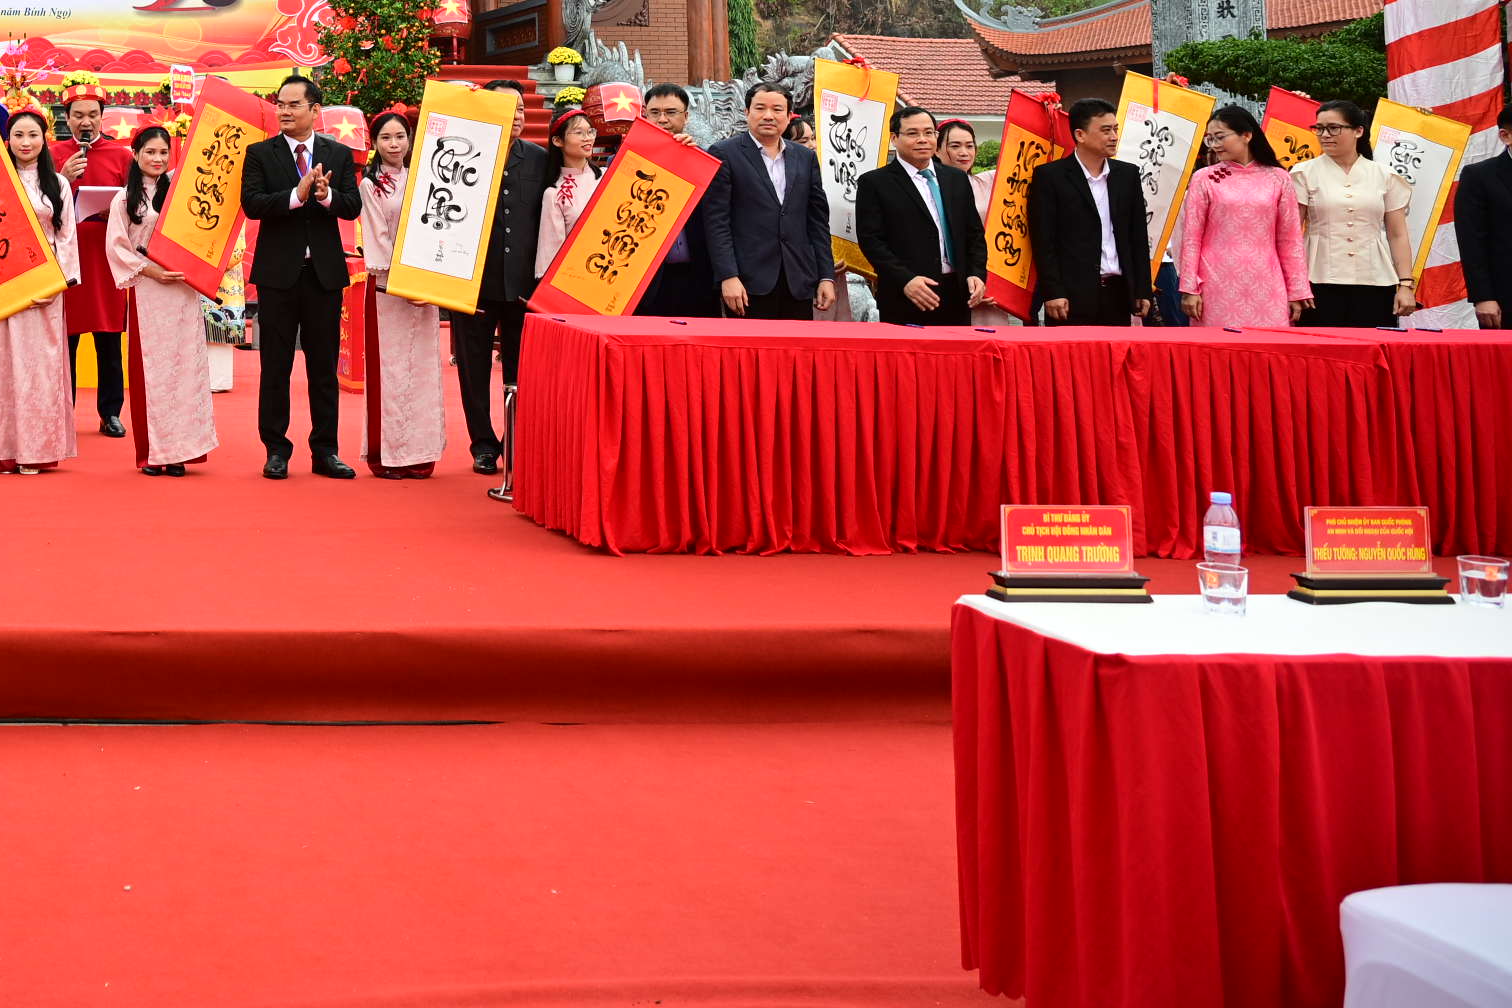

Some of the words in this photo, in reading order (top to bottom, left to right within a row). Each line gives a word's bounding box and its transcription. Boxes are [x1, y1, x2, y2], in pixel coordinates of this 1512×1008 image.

[0, 7, 21, 16] năm
[24, 6, 46, 17] Bính
[49, 7, 72, 19] Ngọ)
[431, 136, 481, 187] Phúc
[420, 182, 469, 230] Lộc
[1016, 545, 1045, 566] TRỊNH
[1047, 545, 1080, 564] QUANG
[1081, 542, 1120, 563] TRƯỜNG
[1314, 542, 1332, 561] THIẾU
[1333, 544, 1358, 561] TƯỚNG:
[1359, 541, 1386, 561] NGUYỄN
[1387, 542, 1406, 561] QUỐC
[1407, 544, 1426, 561] HÙNG
